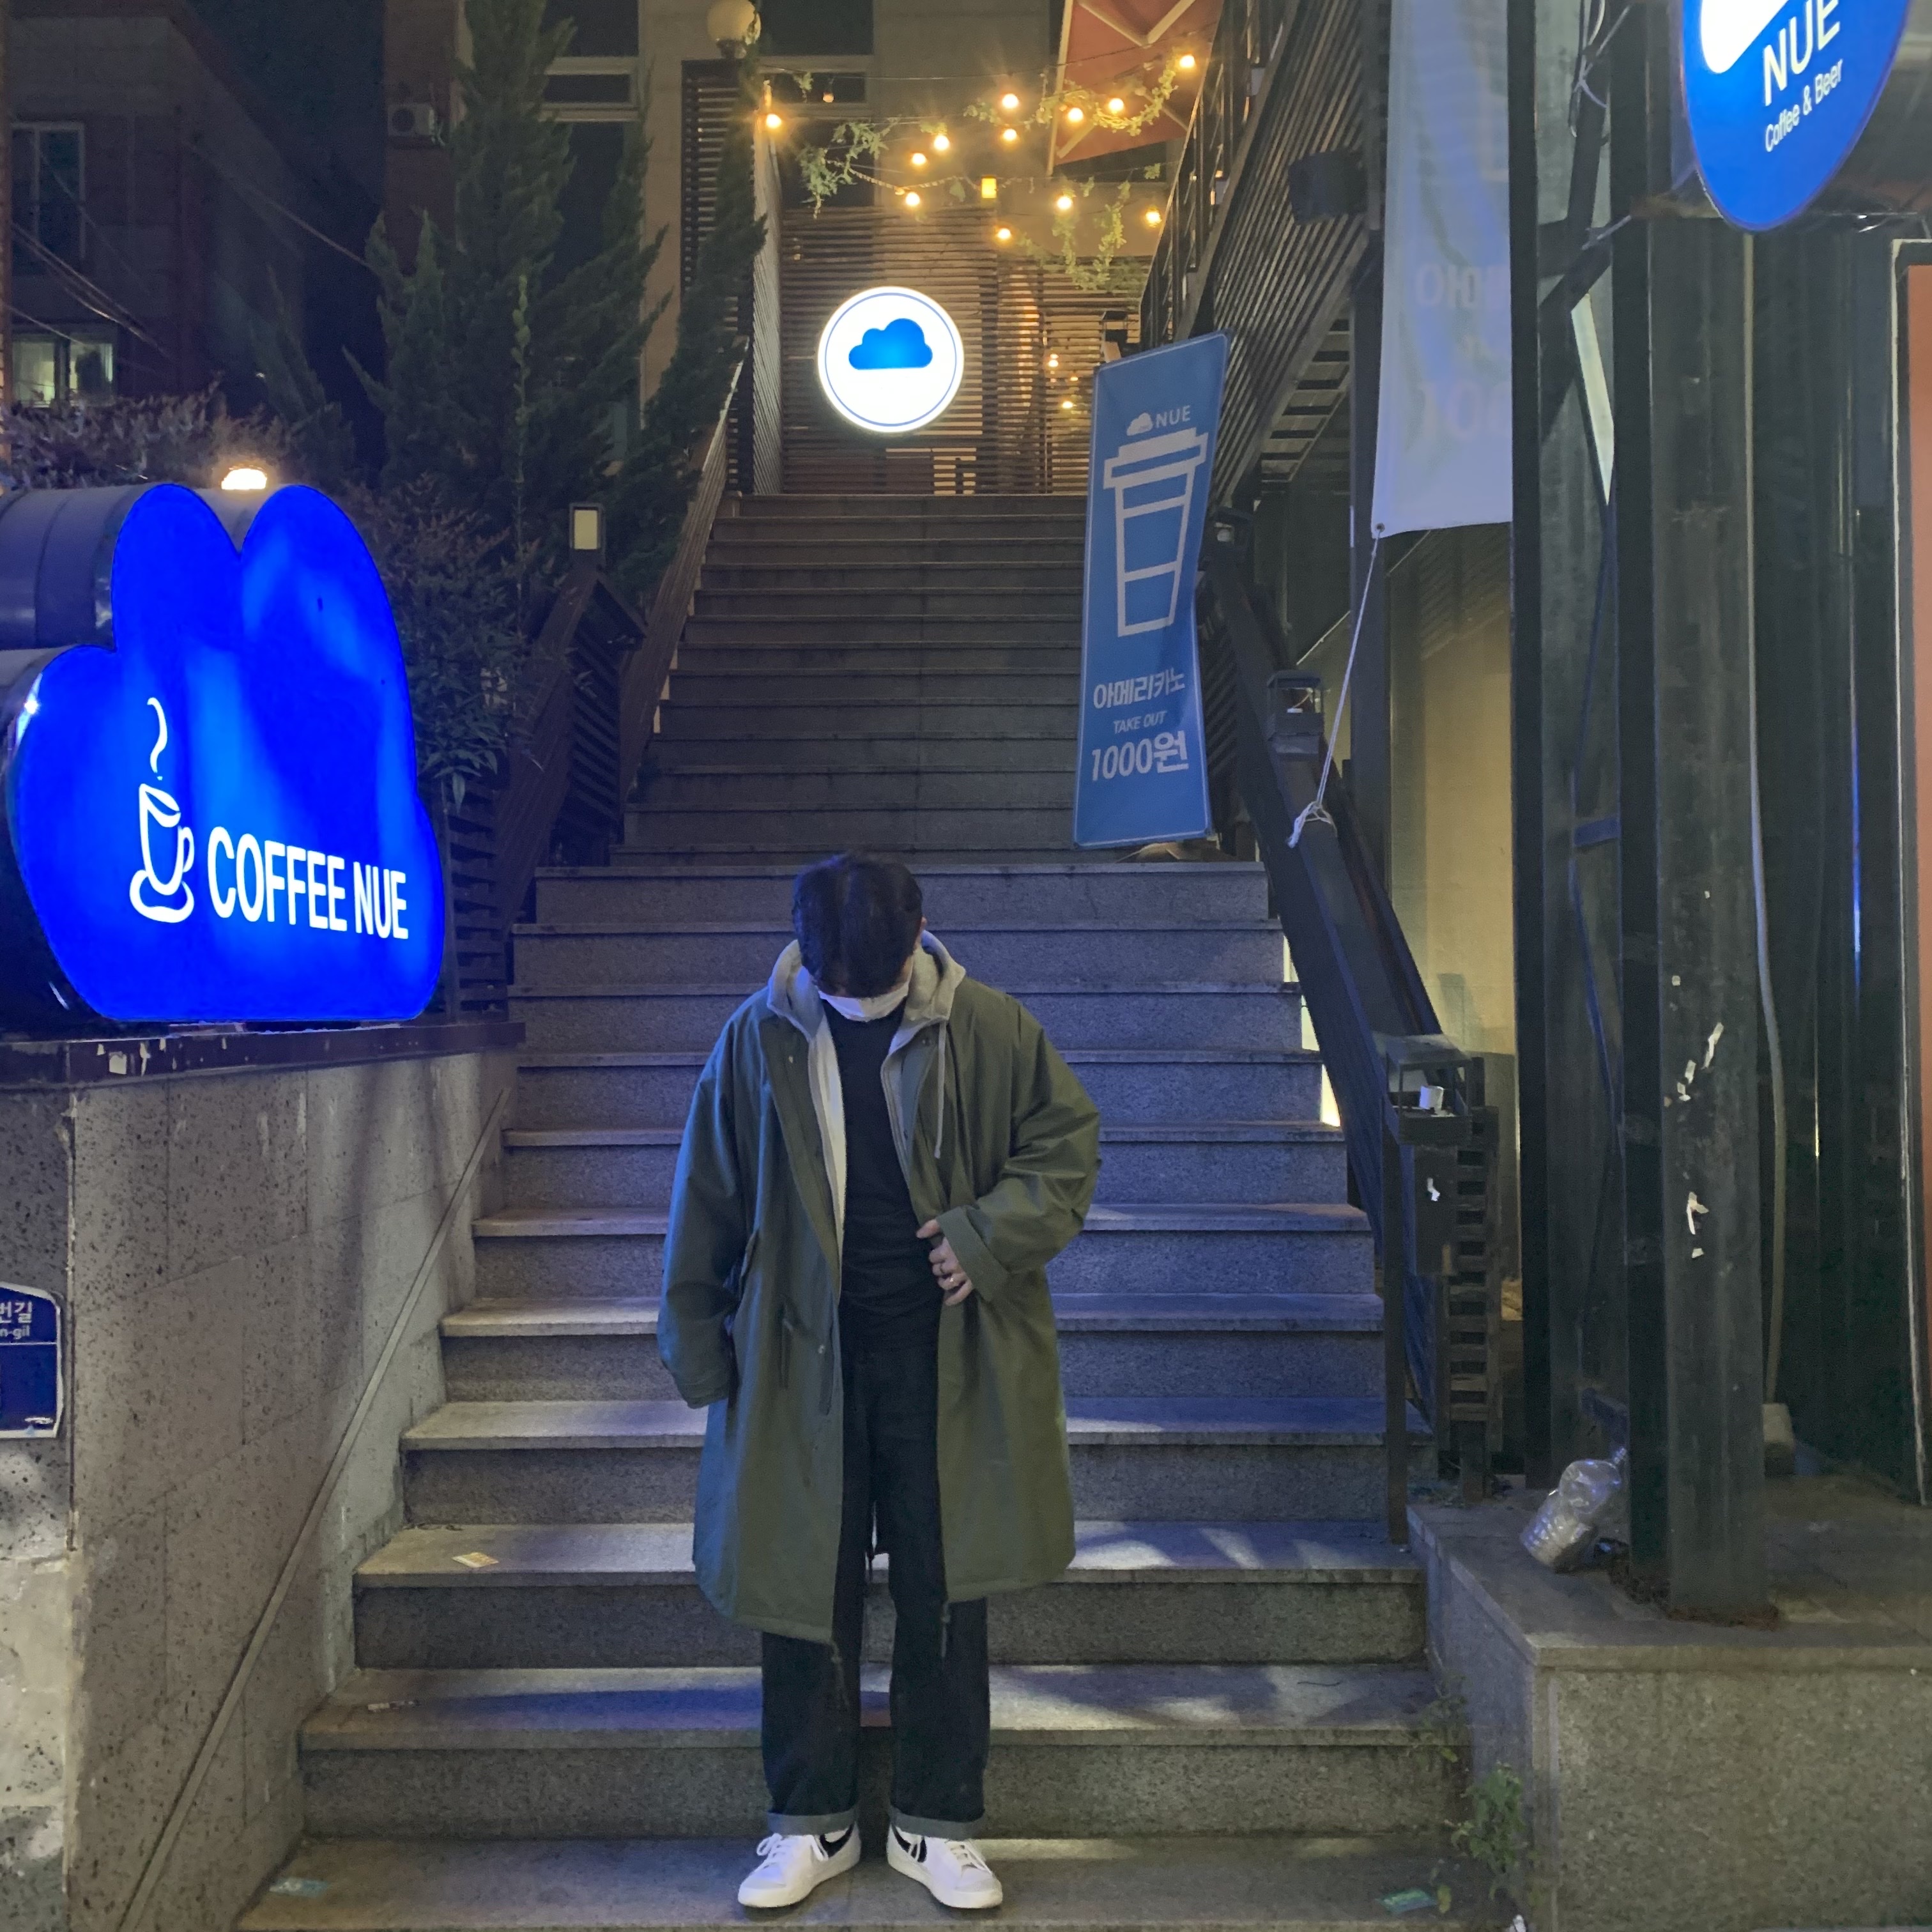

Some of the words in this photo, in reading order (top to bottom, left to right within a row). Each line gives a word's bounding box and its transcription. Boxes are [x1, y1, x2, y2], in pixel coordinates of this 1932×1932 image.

[1765, 104, 1800, 153] Coffee
[1802, 84, 1813, 116] &
[1814, 58, 1843, 105] Beer
[1155, 404, 1191, 429] NUE
[1092, 668, 1185, 709] 아메리카노
[1112, 716, 1141, 735] TAKE
[1144, 710, 1168, 728] OUT
[1091, 730, 1189, 781] 1000원
[208, 826, 347, 931] COFFEE
[353, 861, 409, 939] NUE
